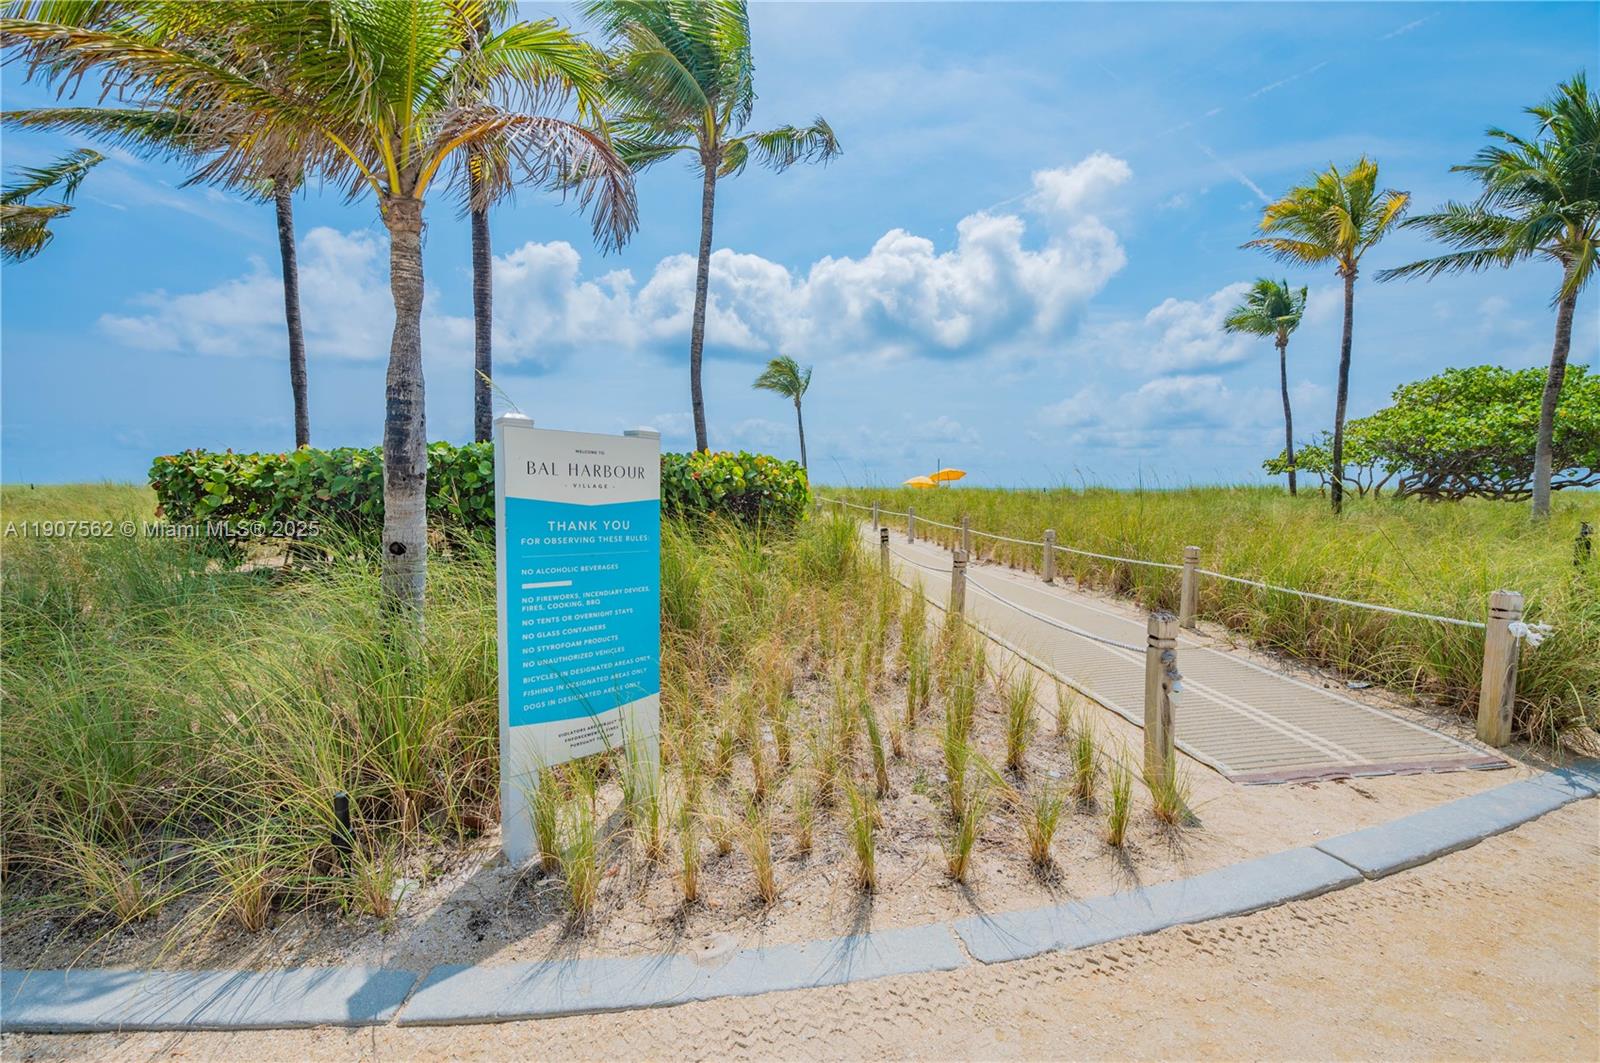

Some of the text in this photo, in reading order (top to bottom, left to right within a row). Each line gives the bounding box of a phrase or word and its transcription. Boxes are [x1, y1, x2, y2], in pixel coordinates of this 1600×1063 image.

[526, 461, 645, 479] BAL HARBOUR
[547, 520, 630, 531] THANK YOU
[520, 537, 540, 545] FOR
[544, 536, 596, 544] OBSERVING
[536, 566, 579, 575] ALCOHOLIC
[581, 563, 619, 571] BEVERAGES
[583, 589, 622, 598] INCENDIARY
[522, 619, 535, 627] NO
[537, 616, 560, 624] TENTS
[574, 610, 613, 620] OVERNIGHT
[615, 608, 634, 616] STAYS
[522, 624, 607, 641] NO GLASS CONTAINERS
[522, 634, 619, 655] NO STYROFOAM PRODUCTS
[522, 646, 625, 669] NO UNAUTHORIZED VEHICLES
[523, 673, 559, 684] BICYCLES
[570, 662, 613, 675] DESIGNATED
[615, 658, 634, 667] AREAS
[635, 655, 651, 663] ONLY
[523, 686, 554, 697] FISHING
[566, 676, 609, 689] DESIGNATED
[610, 671, 630, 680] AREAS
[631, 668, 647, 676] ONLY
[523, 701, 546, 712] DOGS
[547, 698, 556, 706] IN
[624, 681, 641, 690] ONLY
